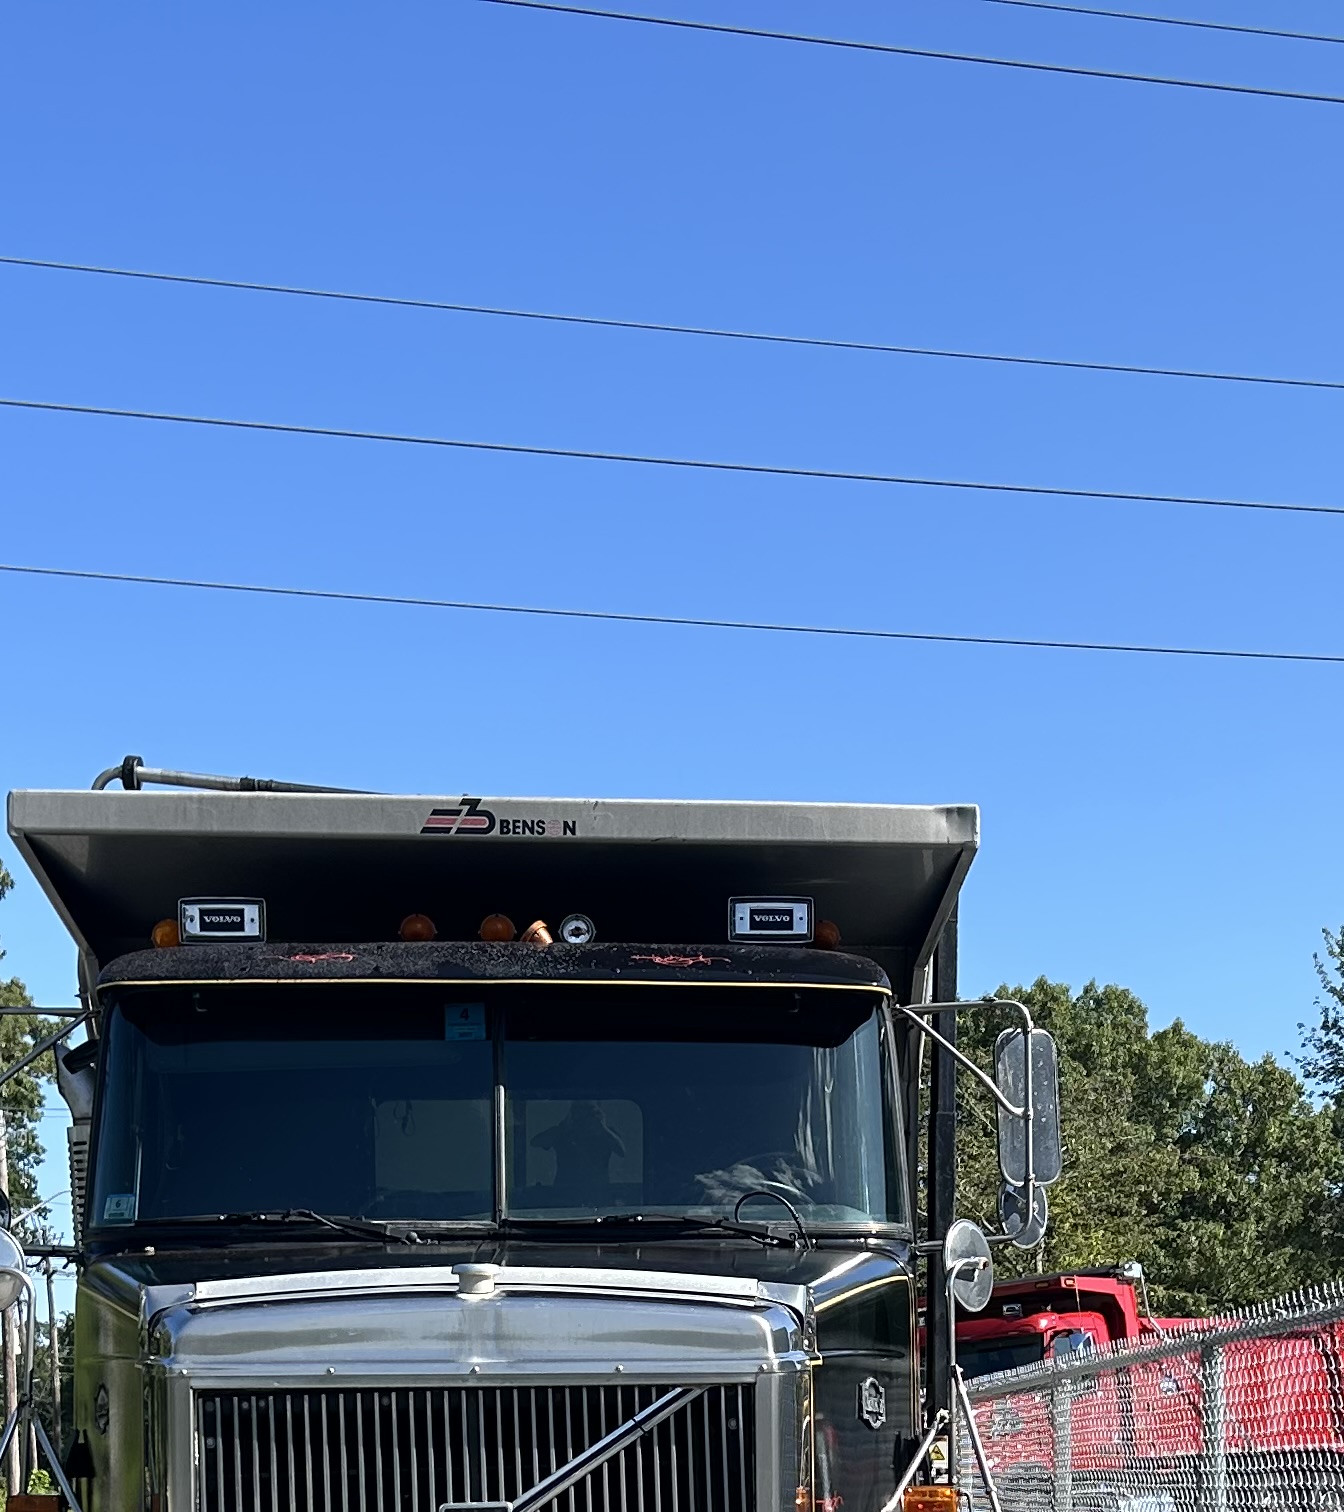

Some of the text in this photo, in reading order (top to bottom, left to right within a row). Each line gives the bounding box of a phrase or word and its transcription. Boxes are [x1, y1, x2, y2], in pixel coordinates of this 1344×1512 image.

[203, 915, 242, 923] VOLVO
[752, 914, 791, 922] VOLVO
[459, 1007, 470, 1021] 4
